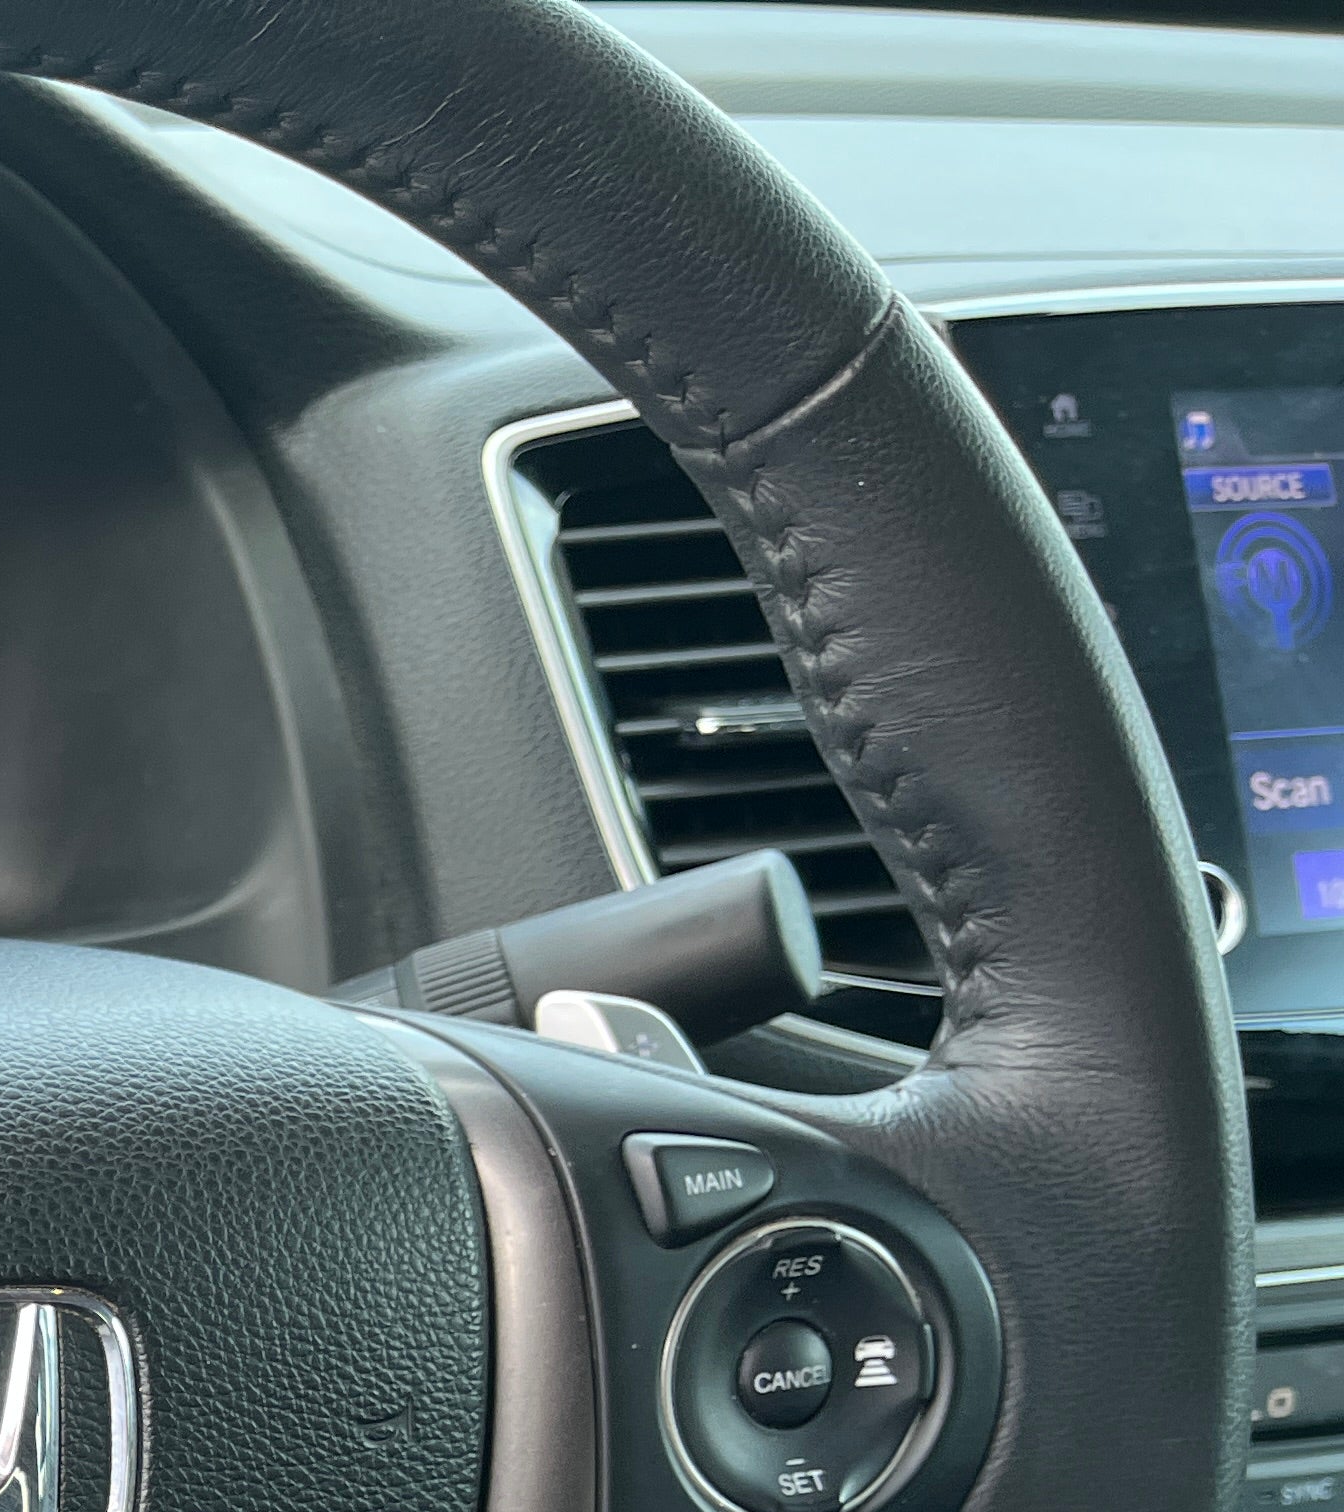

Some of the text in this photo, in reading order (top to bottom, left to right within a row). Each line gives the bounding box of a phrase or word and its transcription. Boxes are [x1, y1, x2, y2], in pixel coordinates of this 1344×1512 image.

[1211, 472, 1306, 503] SOURCE
[1250, 770, 1332, 812] Scan
[685, 1168, 744, 1196] MAIN
[772, 1255, 824, 1279] RES
[753, 1364, 831, 1395] CANCEL
[777, 1469, 826, 1497] SET
